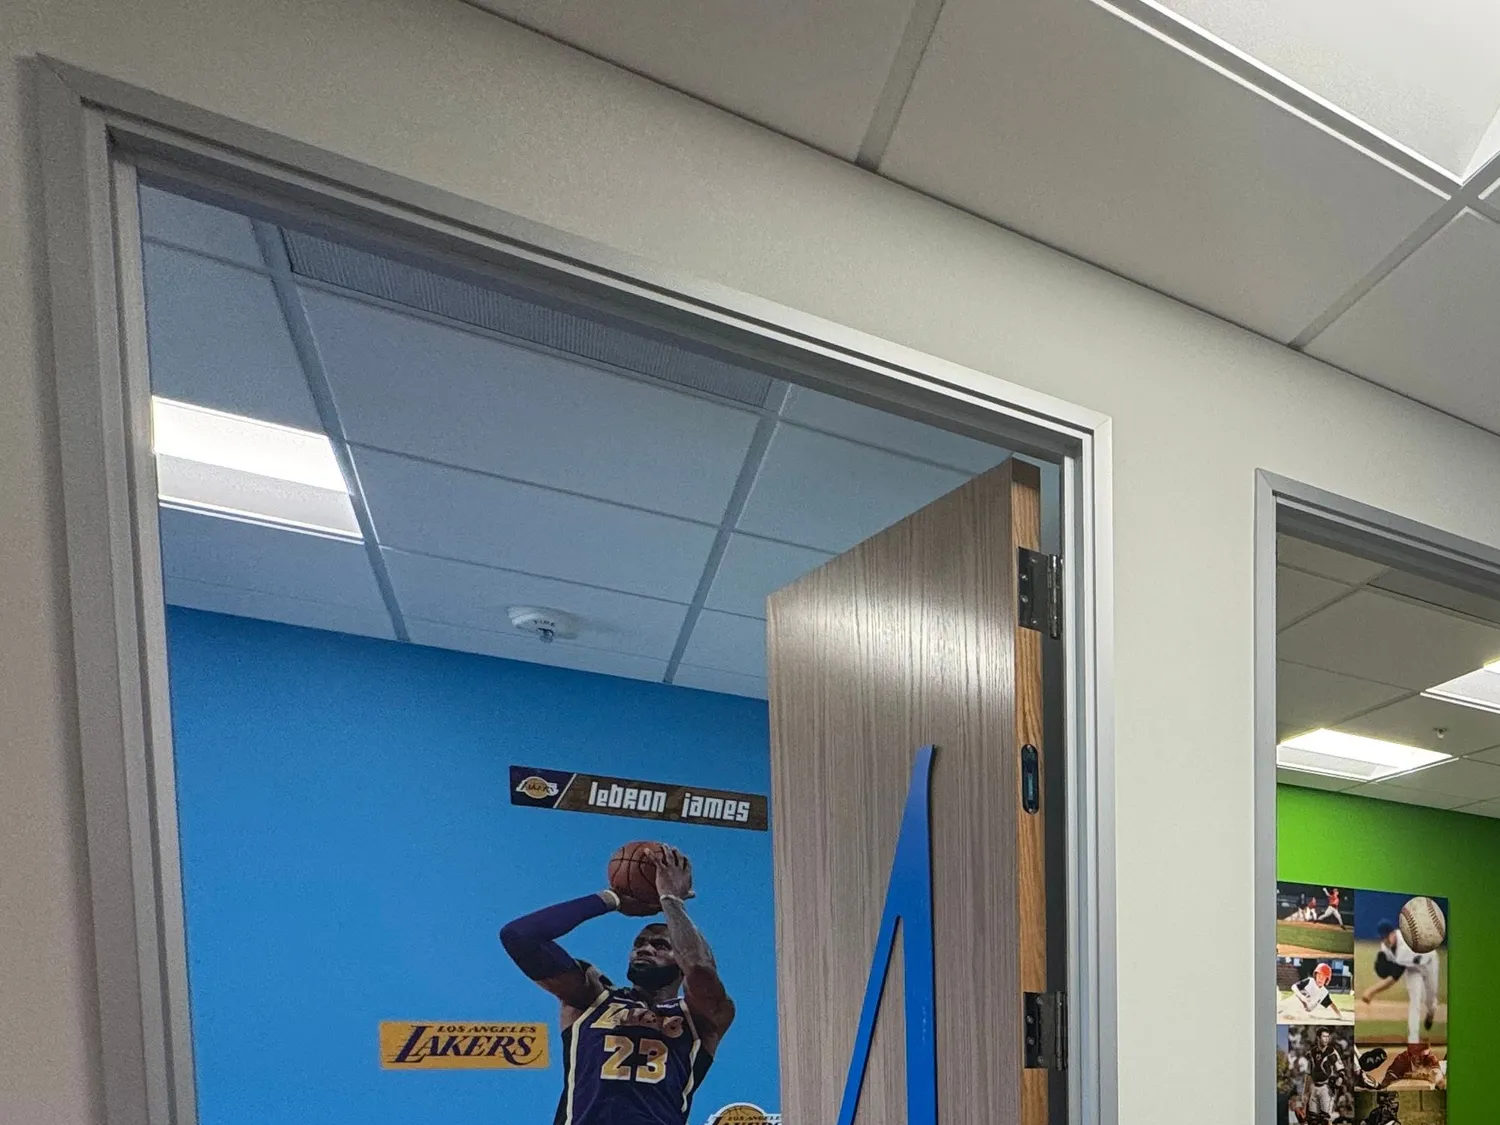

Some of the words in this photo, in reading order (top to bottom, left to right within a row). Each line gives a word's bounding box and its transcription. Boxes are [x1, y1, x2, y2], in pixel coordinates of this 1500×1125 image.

[681, 792, 750, 822] james
[387, 1025, 544, 1066] LAKERS
[437, 1025, 465, 1033] LOS
[468, 1025, 537, 1033] ANGELES
[600, 1034, 669, 1084] 23
